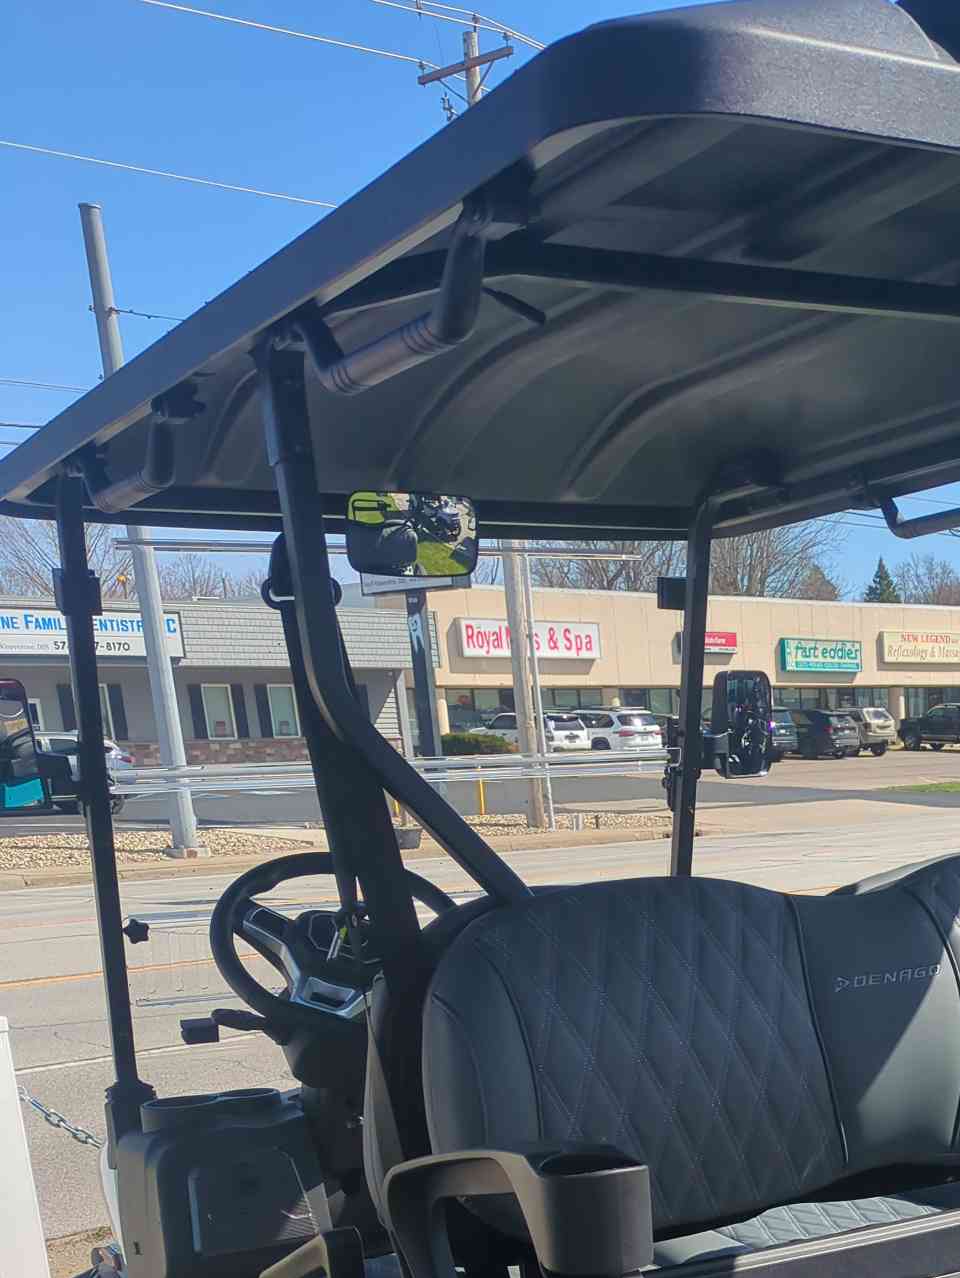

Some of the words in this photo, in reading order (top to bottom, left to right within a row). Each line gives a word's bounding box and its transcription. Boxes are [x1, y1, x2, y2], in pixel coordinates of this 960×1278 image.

[23, 614, 68, 630] FAMIL
[465, 624, 502, 655] Royal
[548, 627, 559, 650] &
[563, 628, 593, 656] Spa
[853, 964, 940, 988] DENAGO
